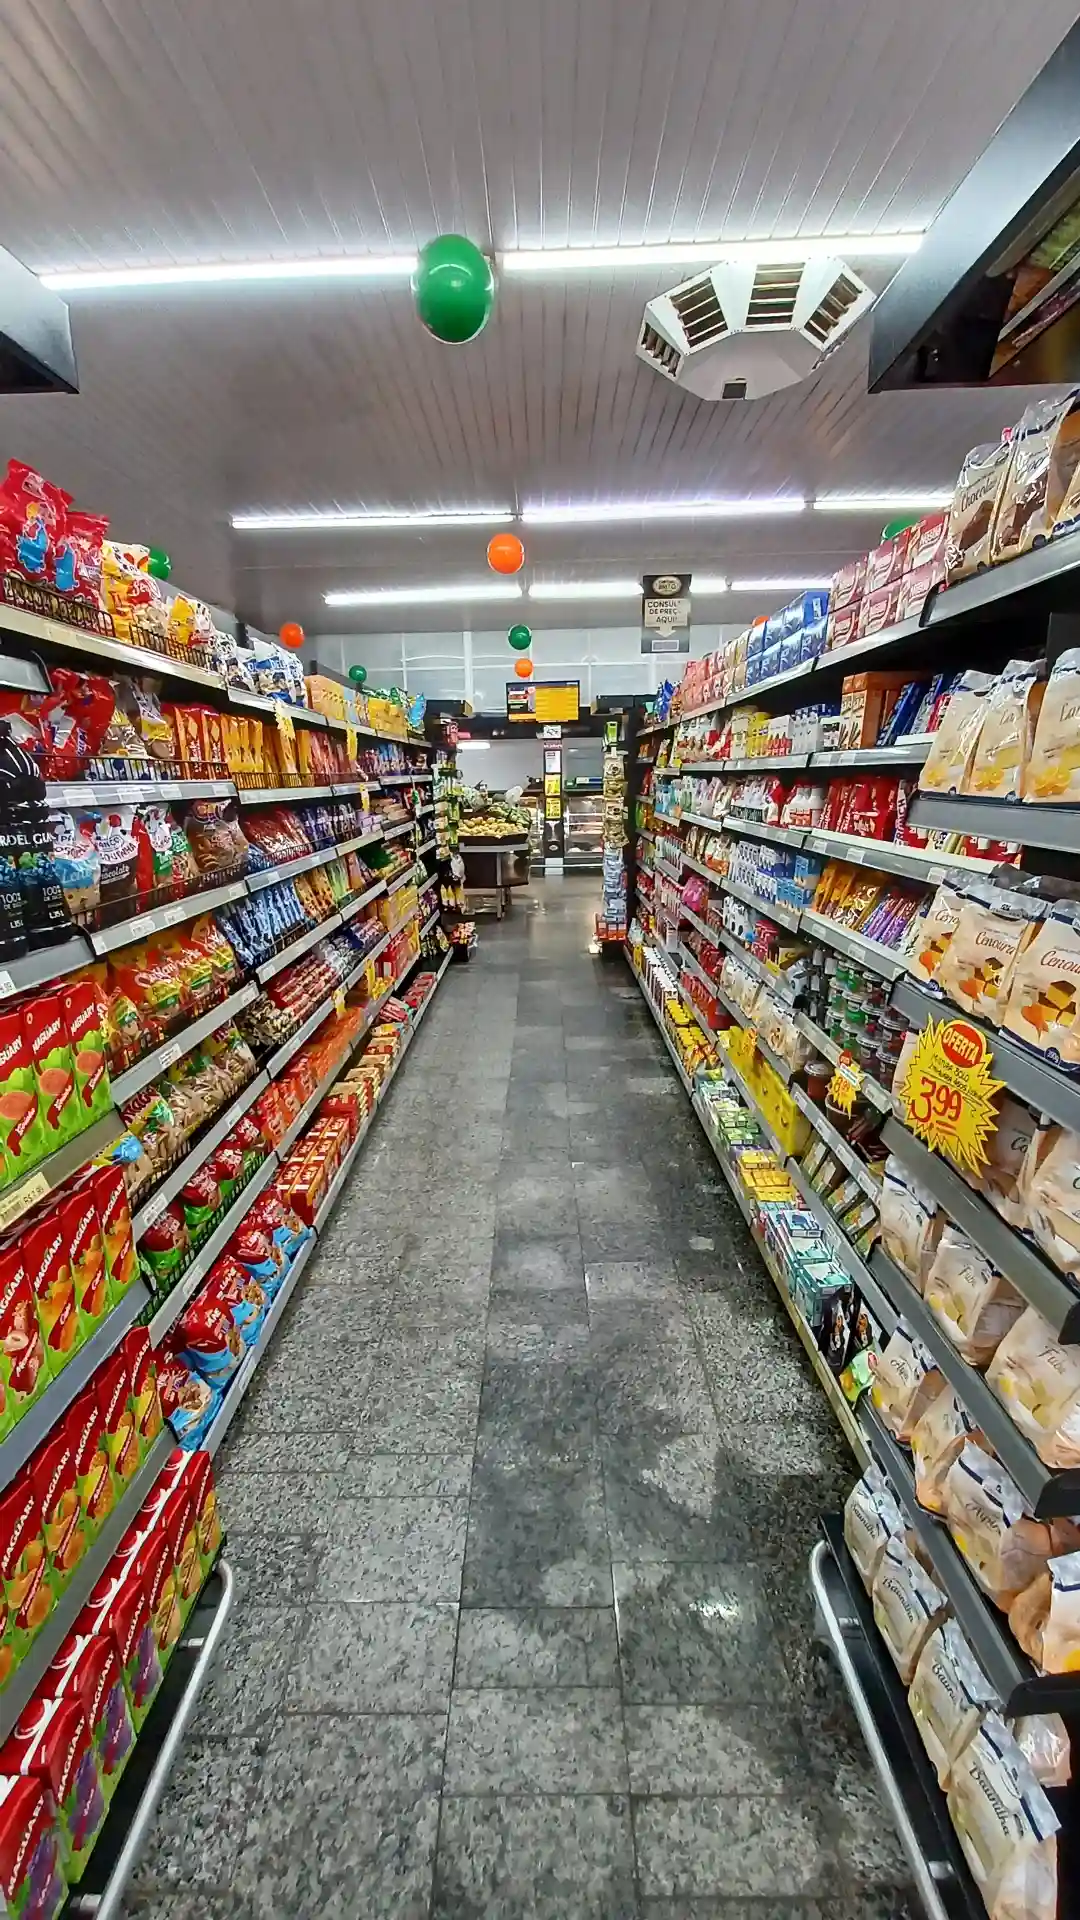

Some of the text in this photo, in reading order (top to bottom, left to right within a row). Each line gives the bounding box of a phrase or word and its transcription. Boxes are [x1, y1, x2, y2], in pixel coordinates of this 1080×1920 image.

[976, 931, 1017, 956] Cenoura
[1040, 951, 1080, 974] Cenou
[32, 1017, 62, 1054] MAGUARY
[71, 1002, 96, 1035] MAGUARY
[943, 1027, 980, 1065] OFERTA
[102, 1177, 126, 1225] MAGUARY
[70, 1205, 97, 1257] MAGUARY
[34, 1233, 63, 1294] MAGUARY
[131, 1337, 151, 1388] MAGUARY
[105, 1369, 127, 1427] MAGUARY
[75, 1406, 99, 1468] MAGUARY
[42, 1448, 71, 1518] MAGUARY
[2, 1496, 35, 1575] MAGUARY
[150, 1544, 169, 1611] MAGUARY
[882, 1576, 915, 1624] Baunilha
[122, 1593, 145, 1665] MAGUARY
[89, 1652, 114, 1729] MAGUARY
[58, 1716, 85, 1802] MAGUARY
[968, 1758, 1011, 1837] Baunilha
[8, 1796, 44, 1897] MAGUARY
